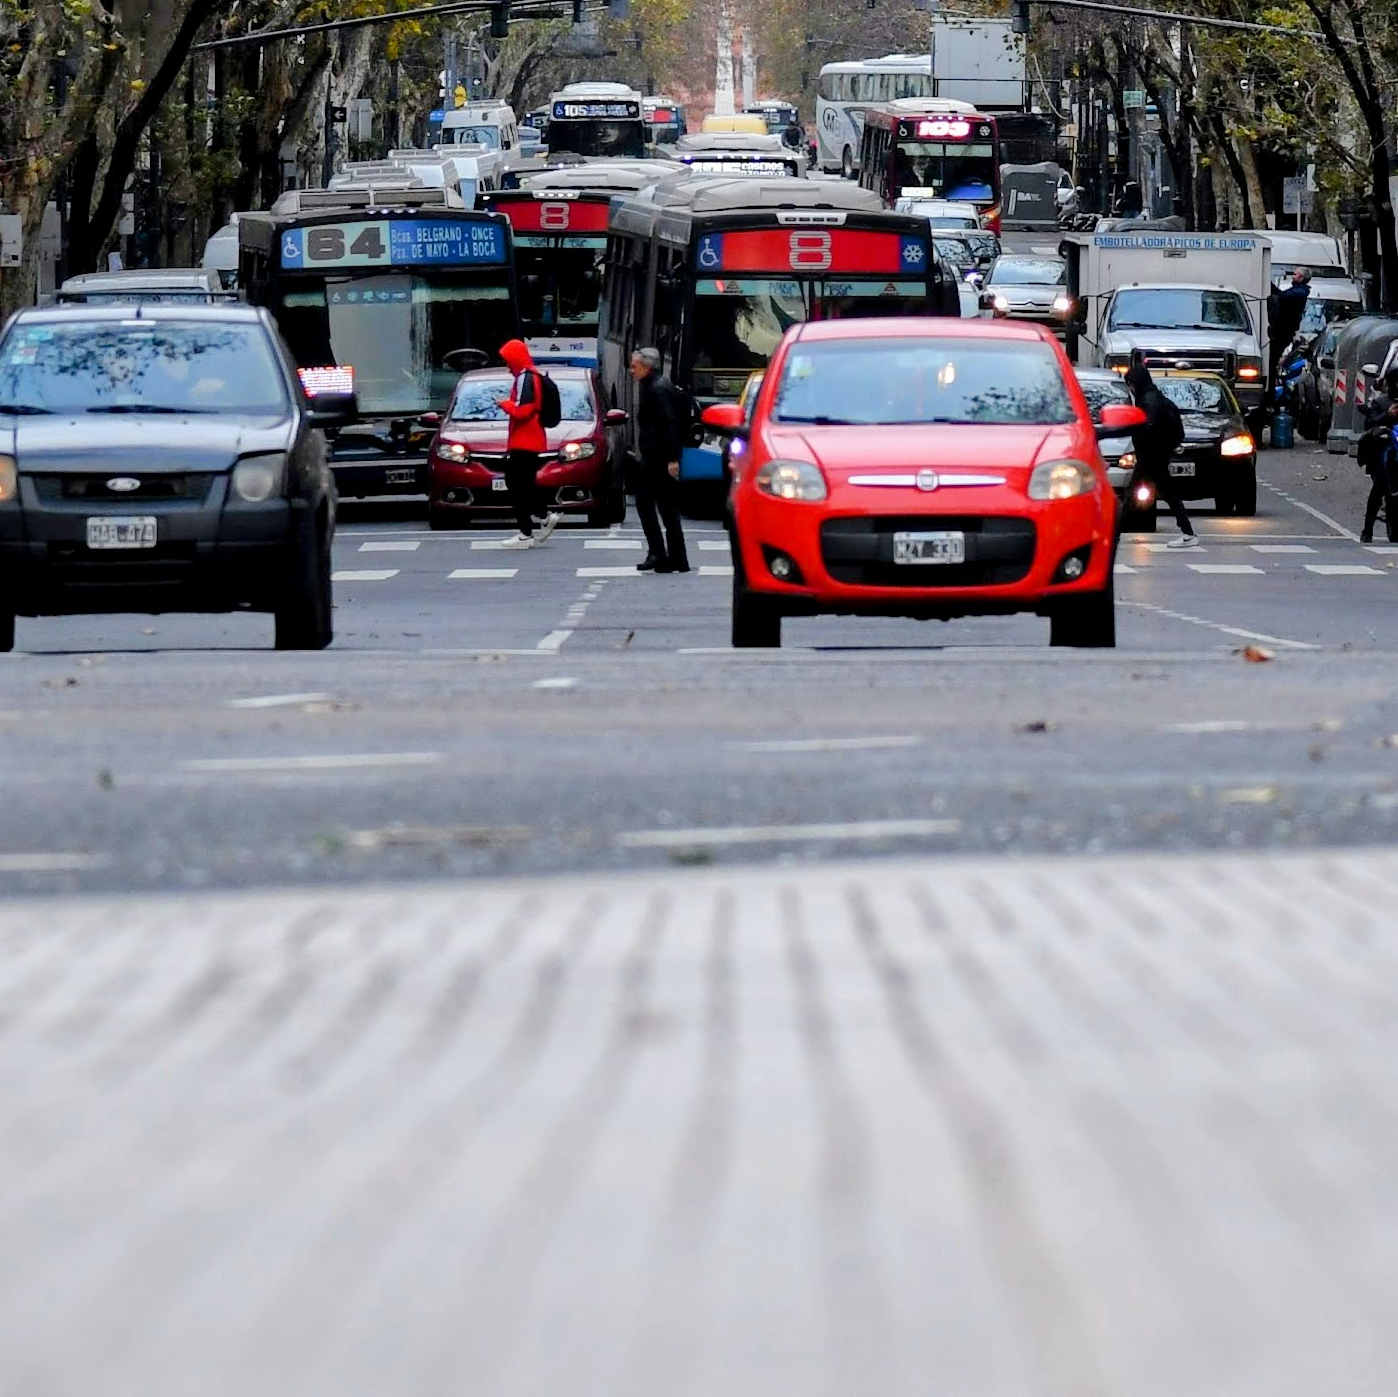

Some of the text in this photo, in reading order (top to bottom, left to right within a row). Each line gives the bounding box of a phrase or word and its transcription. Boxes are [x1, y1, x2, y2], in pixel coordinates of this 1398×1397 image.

[540, 202, 570, 230] 8
[307, 227, 386, 261] 84
[416, 227, 462, 243] BELGRANO
[472, 226, 494, 241] ONCE
[1174, 237, 1201, 248] PICOS
[1205, 239, 1216, 248] DE
[1219, 239, 1256, 249] EUROPA
[412, 244, 424, 259] DE
[426, 243, 449, 258] MAYO
[458, 243, 470, 258] LA
[473, 242, 496, 257] BOCA
[789, 230, 832, 270] 8
